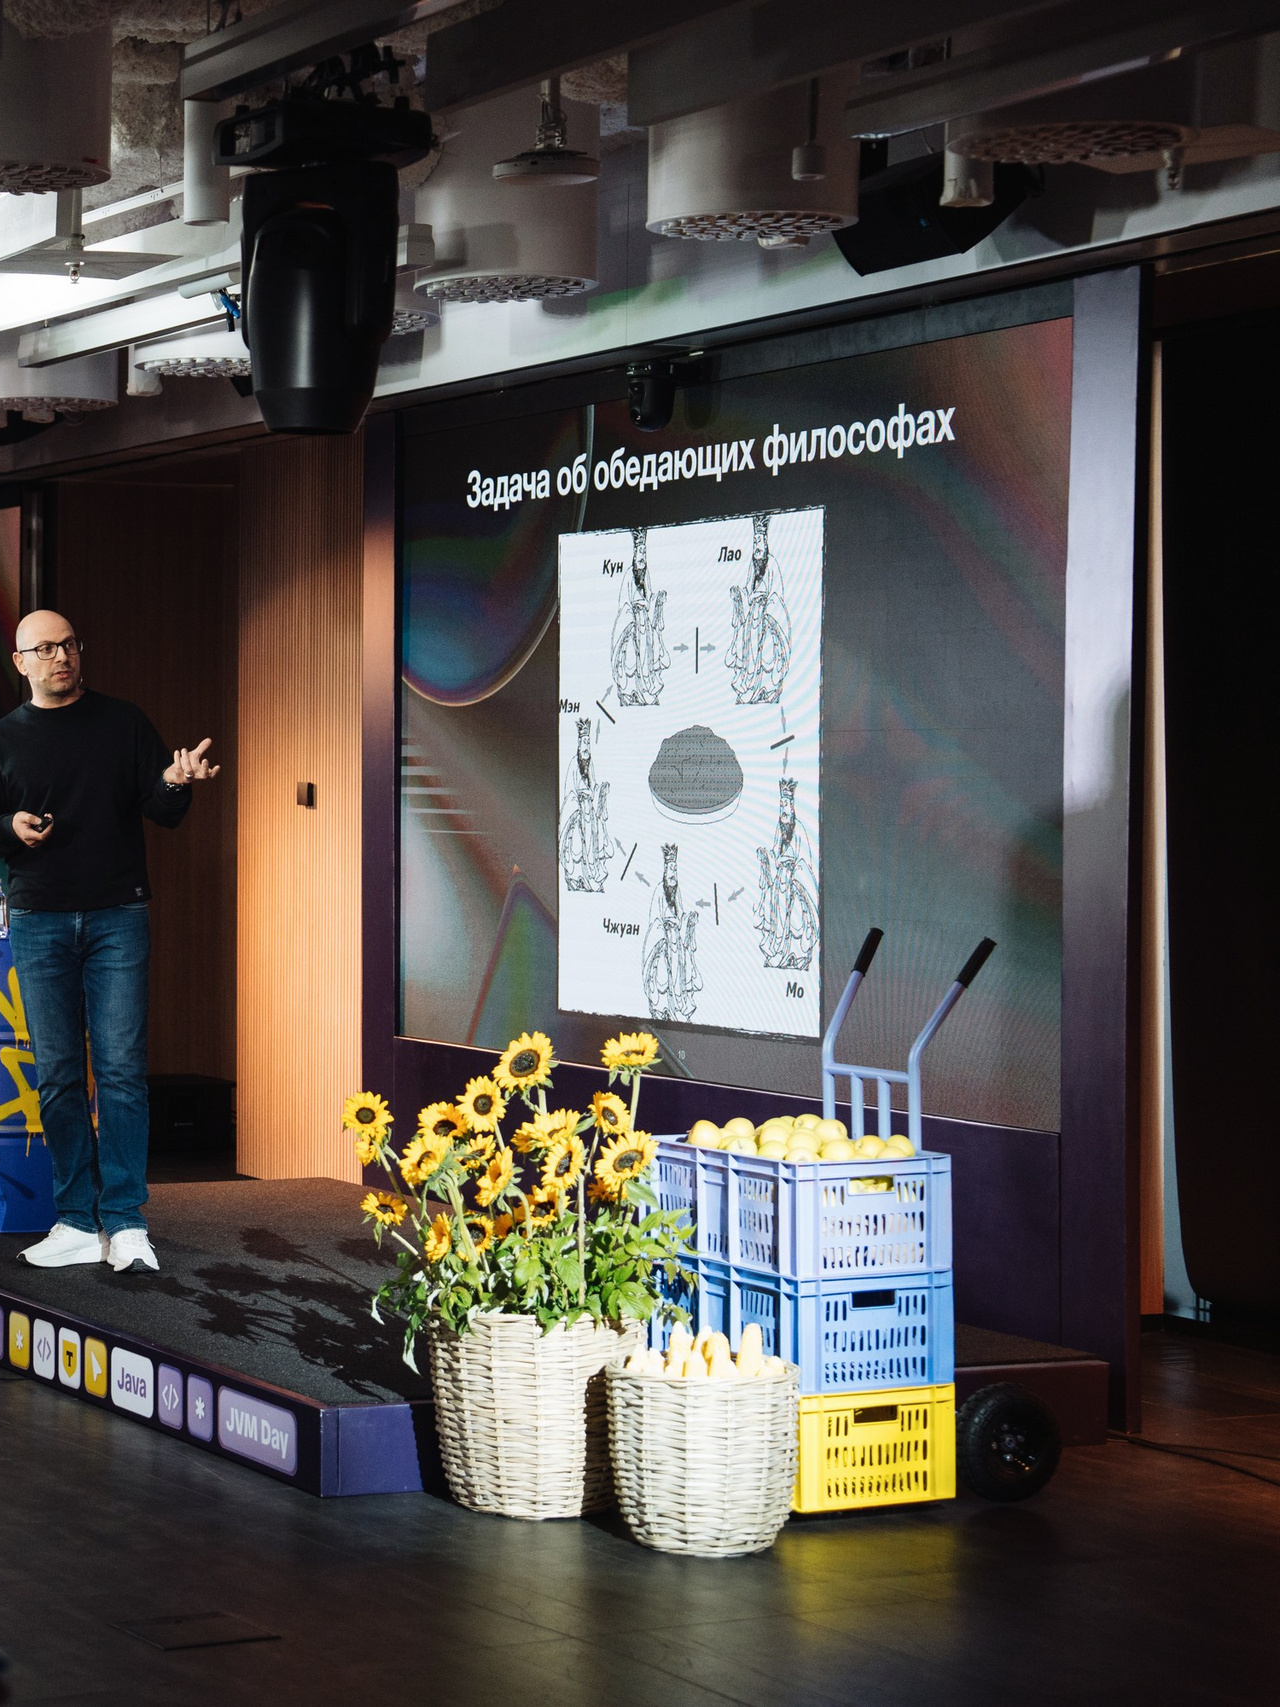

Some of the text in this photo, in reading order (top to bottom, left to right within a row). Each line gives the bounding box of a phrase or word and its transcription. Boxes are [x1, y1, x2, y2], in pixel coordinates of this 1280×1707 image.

[466, 402, 956, 511] Задача об обедающих философах
[717, 546, 742, 563] Лао
[602, 558, 624, 577] Кун
[559, 698, 581, 713] Мэн
[602, 917, 640, 937] Чжуан
[785, 980, 805, 1000] Мо
[66, 1350, 74, 1367] T
[117, 1366, 147, 1399] Java
[226, 1407, 289, 1459] JVM Day
